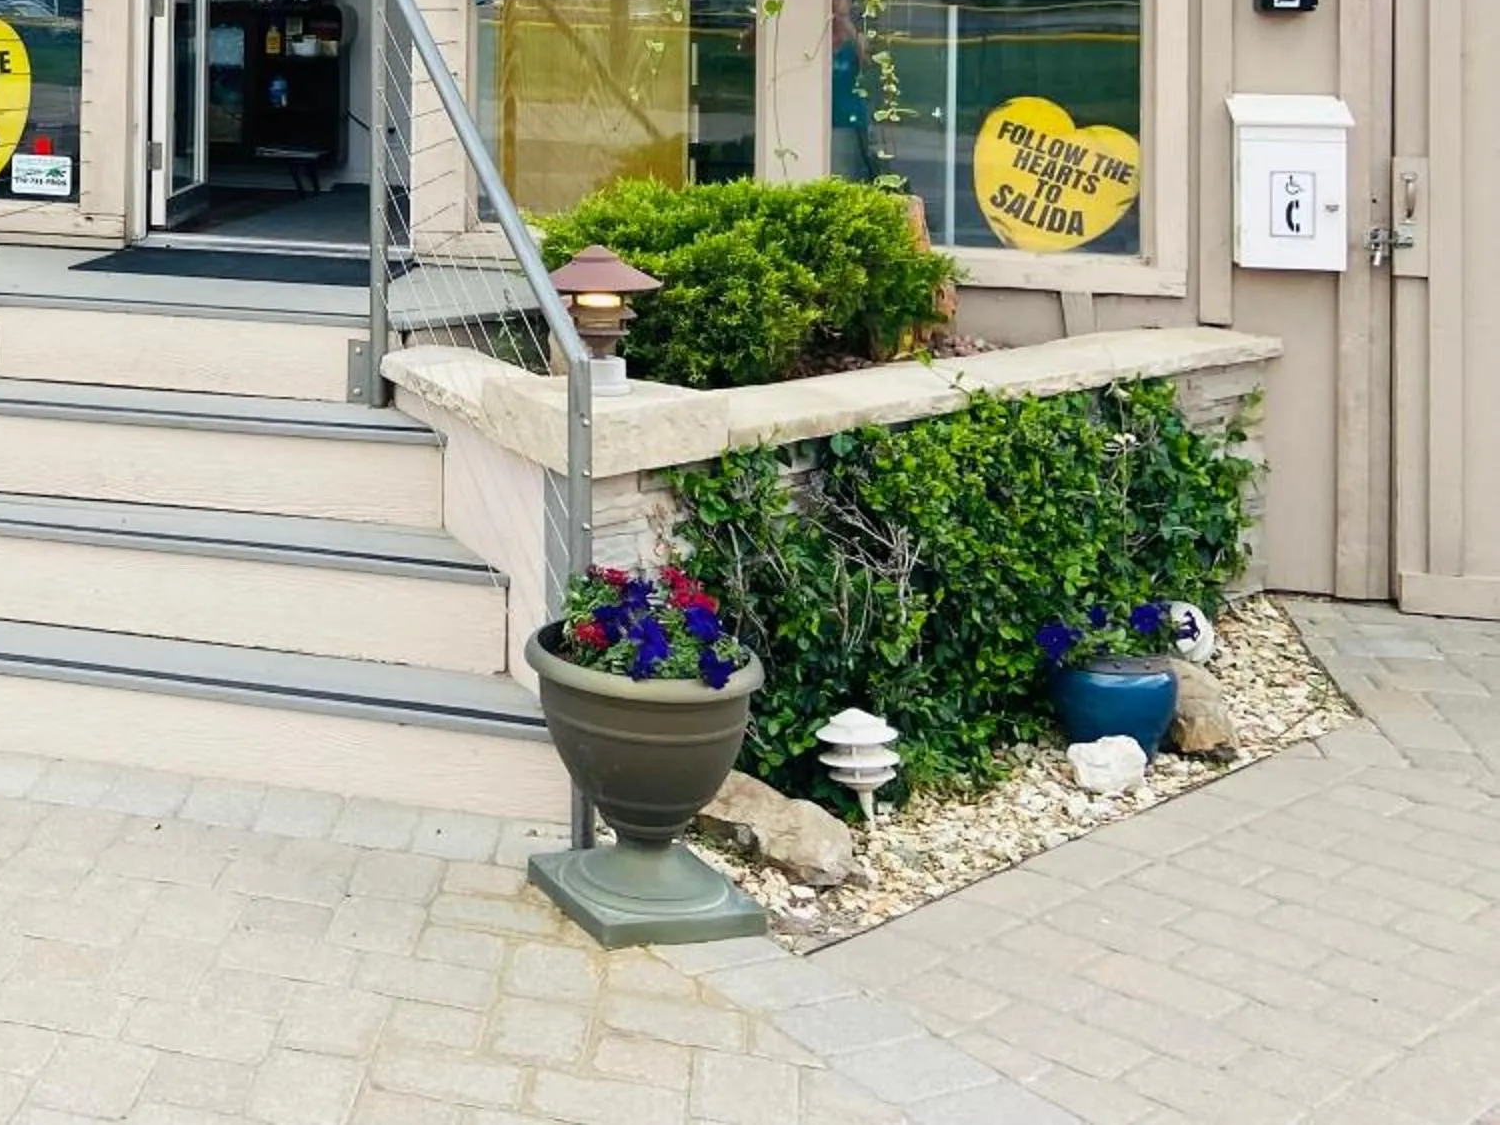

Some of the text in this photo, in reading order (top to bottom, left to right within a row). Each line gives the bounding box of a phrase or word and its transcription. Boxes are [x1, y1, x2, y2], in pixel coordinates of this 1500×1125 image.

[997, 120, 1136, 185] FOLLOW THE
[1012, 148, 1100, 195] HEARTS
[990, 183, 1084, 237] SALIDA
[1034, 178, 1063, 204] TO
